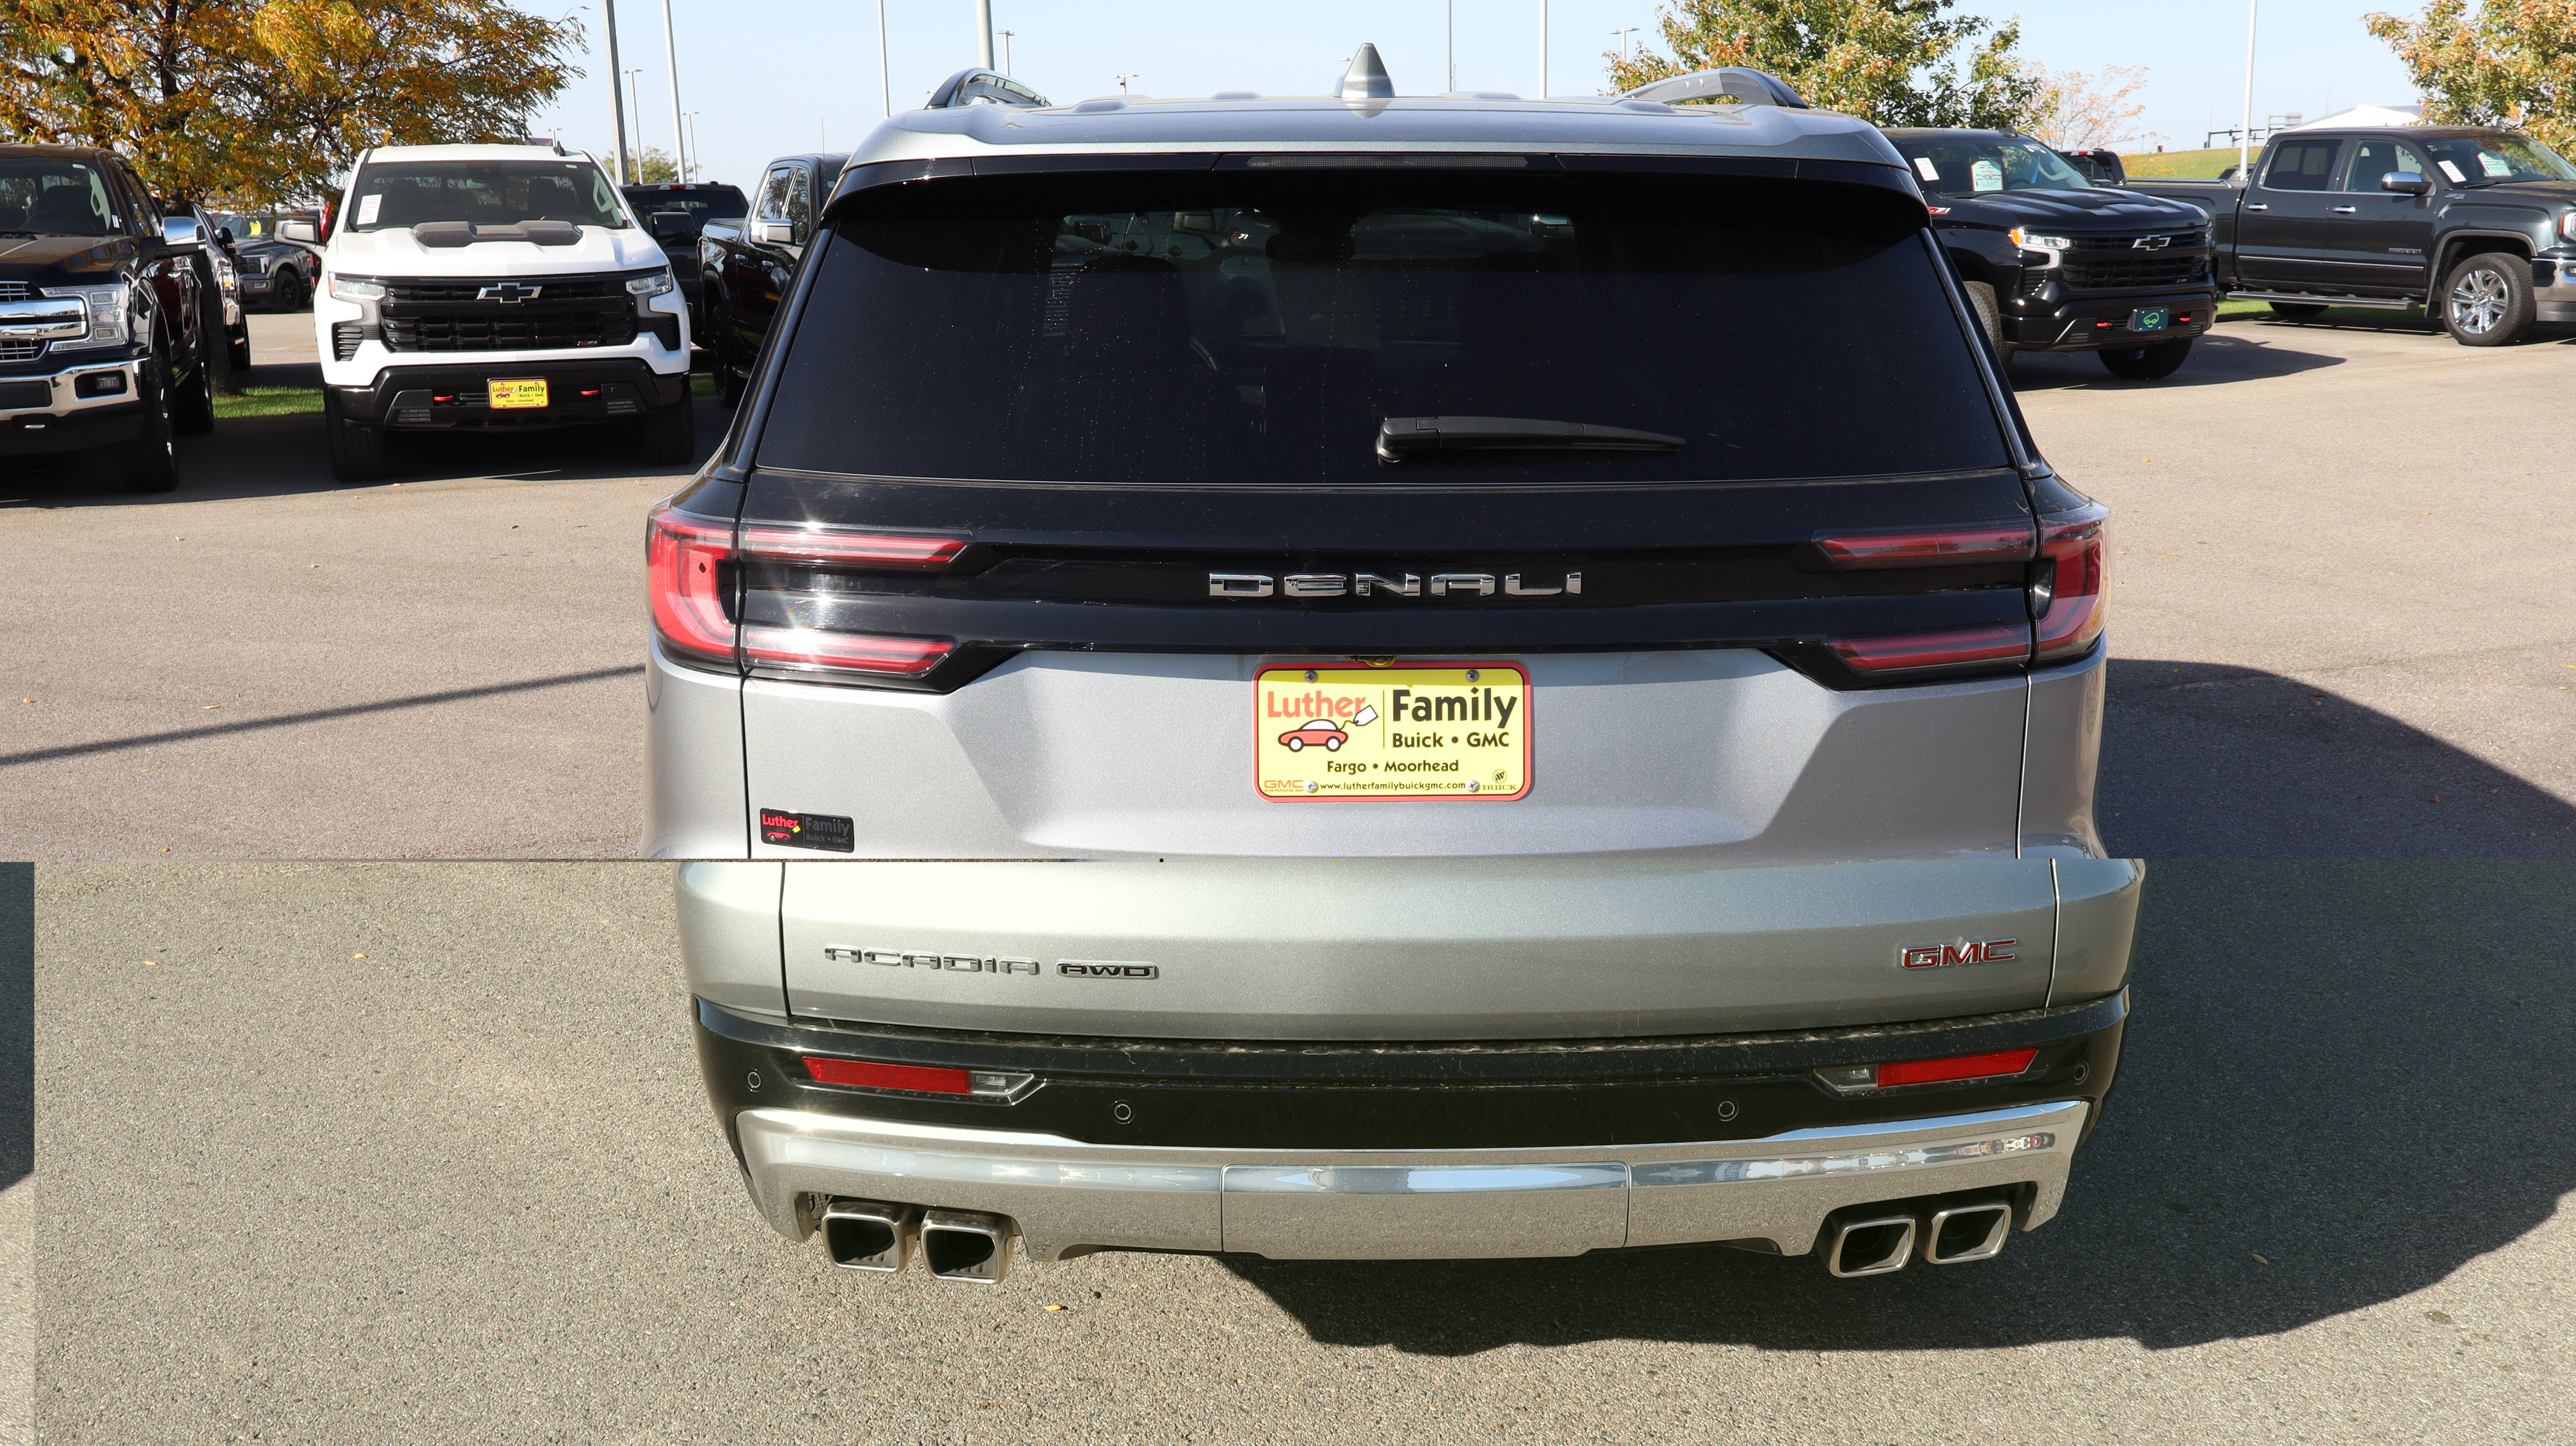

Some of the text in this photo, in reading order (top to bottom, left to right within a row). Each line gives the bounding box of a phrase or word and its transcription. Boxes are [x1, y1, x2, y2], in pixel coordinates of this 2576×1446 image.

[1230, 231, 1249, 241] Z71
[519, 385, 545, 393] Family
[1209, 572, 1582, 597] DENALI
[1267, 687, 1518, 729] Luther Family
[1393, 732, 1509, 748] Buick GMC
[1327, 759, 1459, 775] Fargo Moorhead
[1264, 780, 1304, 788] GMC
[1320, 781, 1466, 791] www.lutherfamilybuickgmc.com
[762, 814, 850, 837] Luther Family
[806, 833, 849, 844] Buick GMC
[824, 943, 1153, 977] ACADIA AWD
[1902, 938, 2017, 969] GMC
